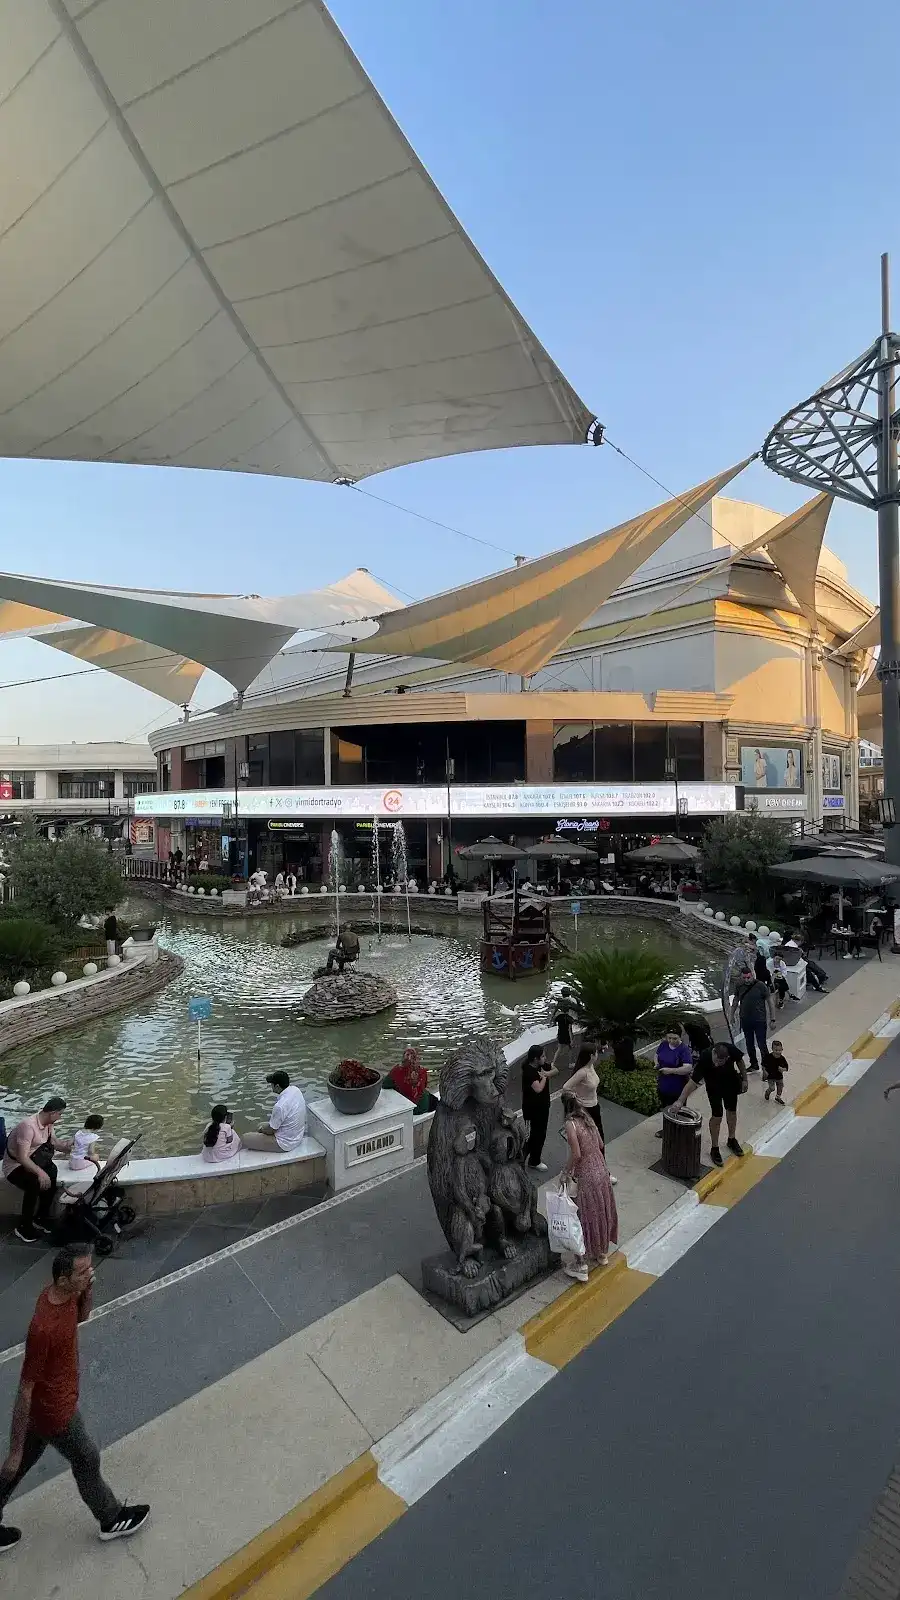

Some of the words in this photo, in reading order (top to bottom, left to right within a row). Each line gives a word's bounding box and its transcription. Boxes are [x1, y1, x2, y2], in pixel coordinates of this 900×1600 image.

[173, 799, 186, 810] 87.8
[388, 797, 400, 806] 24
[356, 1134, 395, 1156] VIALAND
